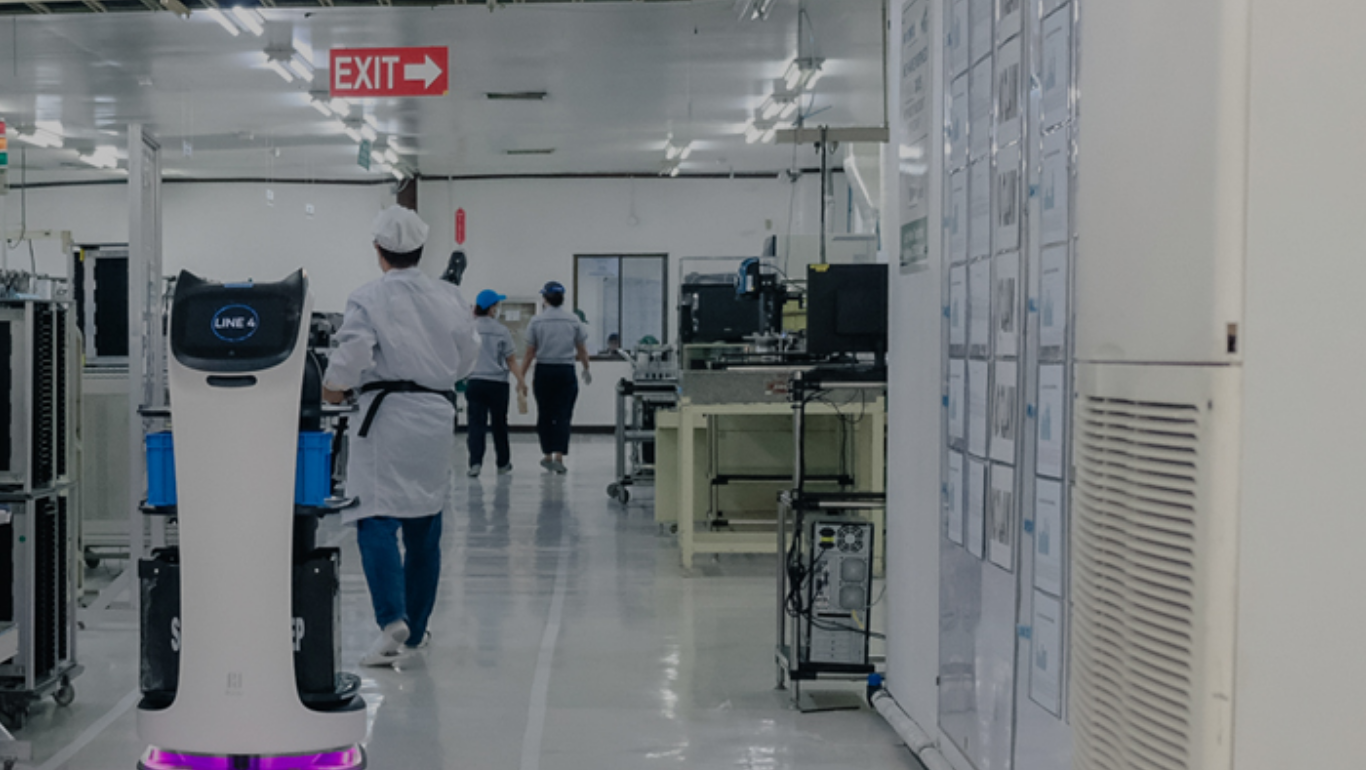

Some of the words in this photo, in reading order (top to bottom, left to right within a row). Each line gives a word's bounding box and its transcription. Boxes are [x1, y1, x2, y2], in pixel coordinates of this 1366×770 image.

[335, 56, 400, 89] EXIT
[214, 316, 245, 329] LINE
[246, 316, 256, 328] 4
